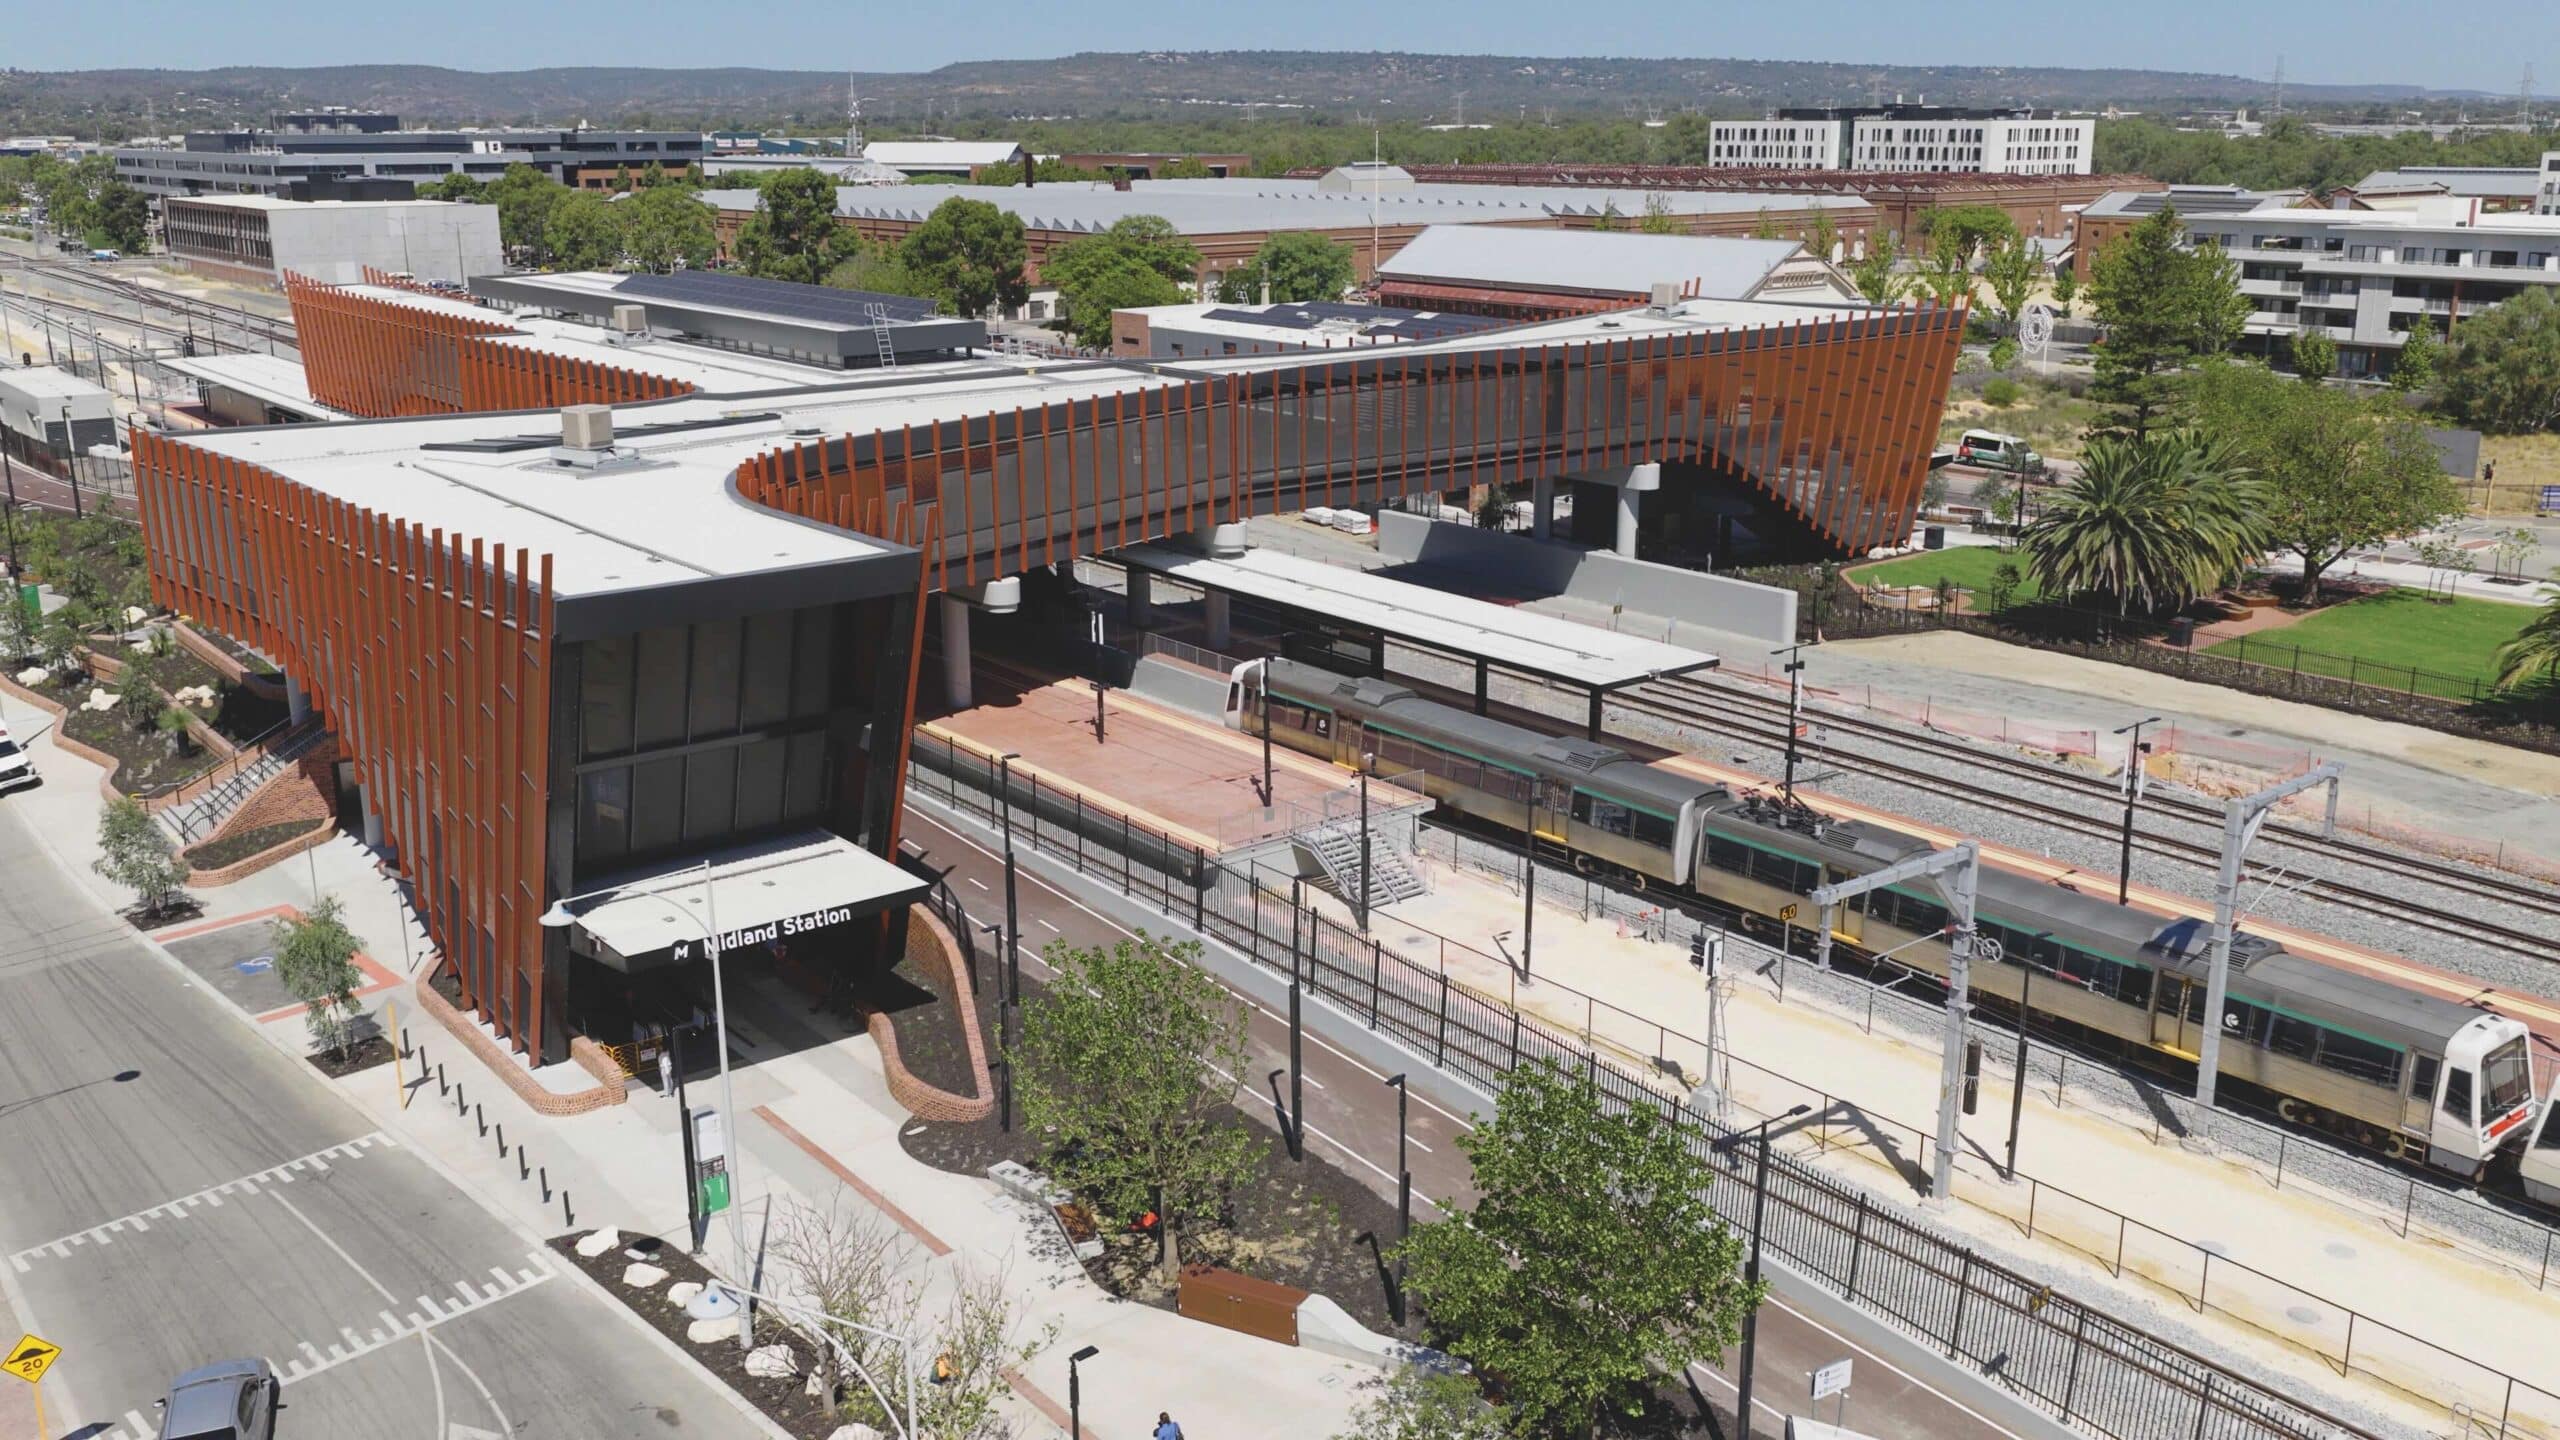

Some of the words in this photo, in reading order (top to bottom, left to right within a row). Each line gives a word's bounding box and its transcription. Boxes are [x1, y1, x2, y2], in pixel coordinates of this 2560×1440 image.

[703, 921, 778, 956] Midland
[783, 907, 852, 936] Station
[22, 1358, 42, 1372] 20
